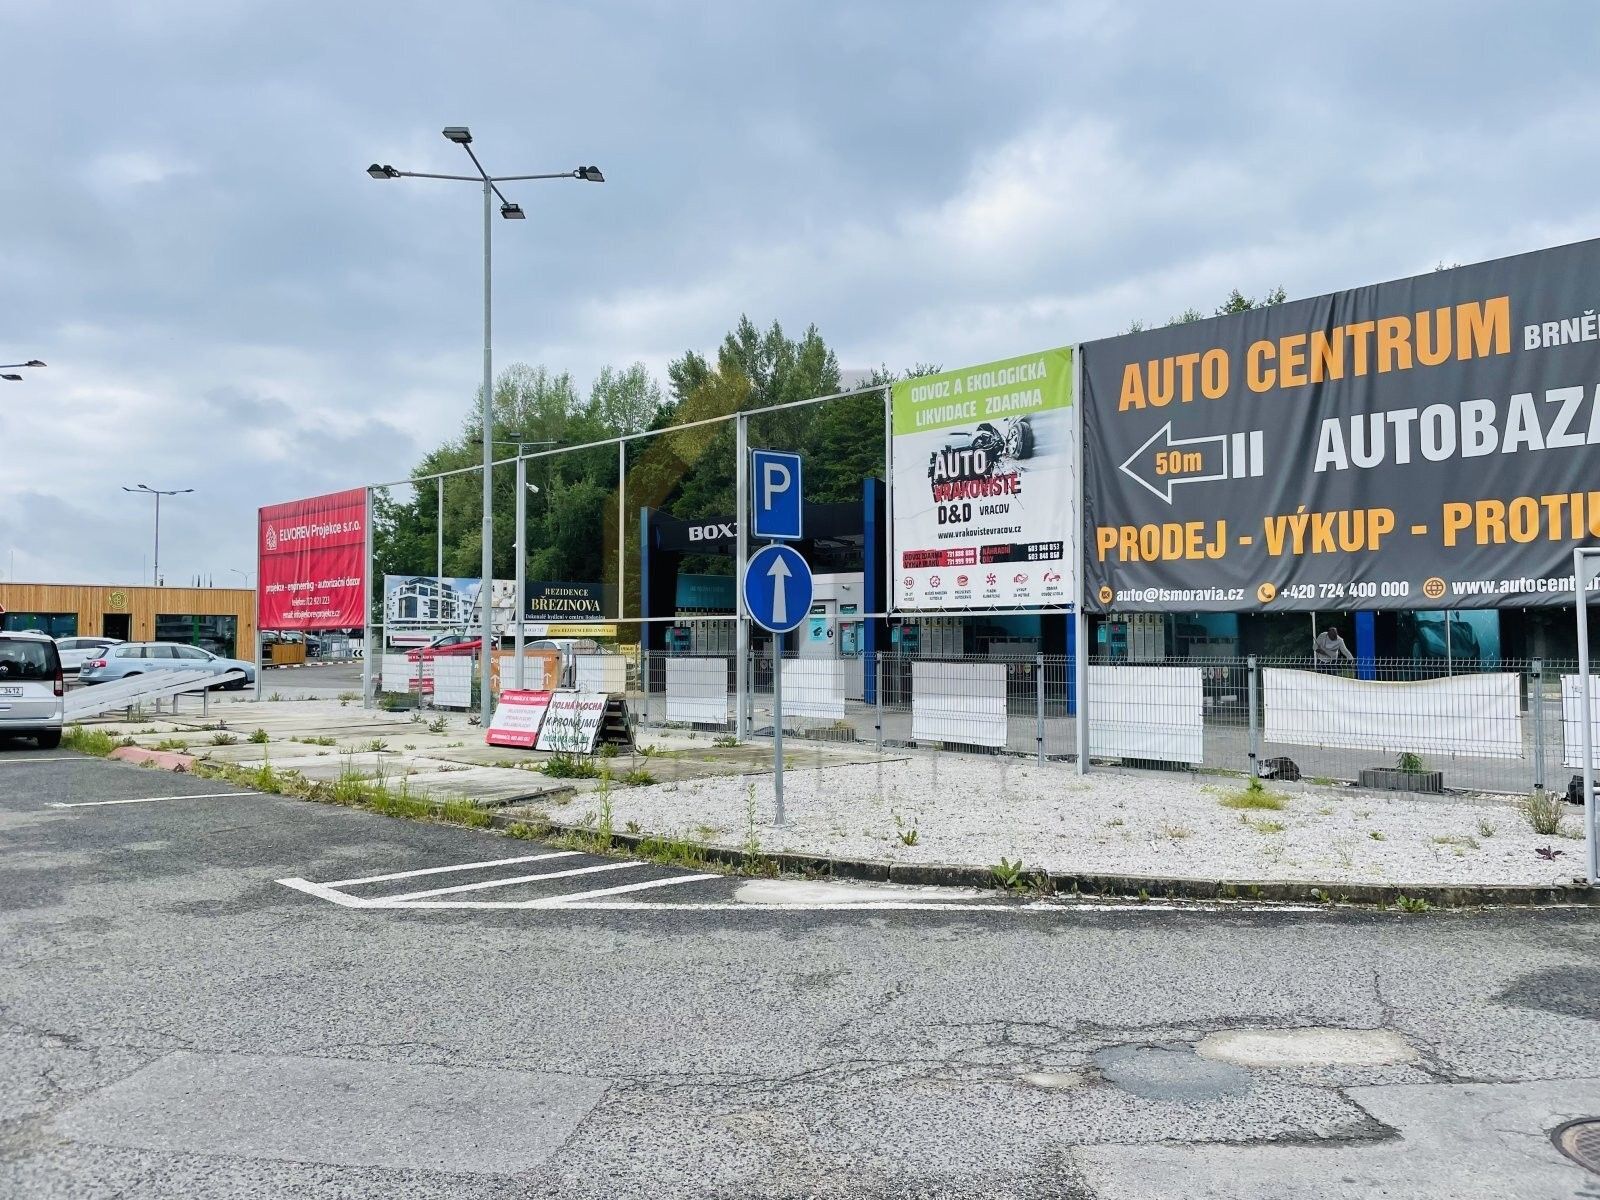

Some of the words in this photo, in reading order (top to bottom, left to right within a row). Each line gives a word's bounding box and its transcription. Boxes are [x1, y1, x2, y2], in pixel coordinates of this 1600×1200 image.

[1524, 309, 1600, 351] BRNĚ
[1118, 348, 1229, 412] AUTO
[1247, 295, 1512, 393] CENTRUM
[911, 381, 950, 403] ODVOZ
[954, 378, 962, 395] A
[967, 360, 1047, 392] EKOLOGICKÁ
[916, 400, 977, 426] LIKVIDACE
[985, 388, 1042, 414] ZDARMA
[934, 449, 986, 479] AUTO
[1156, 450, 1202, 475] 50m
[763, 462, 791, 511] P
[938, 503, 972, 524] D&D
[979, 503, 1009, 516] VRACOV
[280, 525, 310, 541] ELVOREV
[311, 522, 341, 539] Projekce
[343, 520, 361, 533] s.r.o.
[938, 526, 1021, 539] www.vrakovistevracov.cz
[1097, 520, 1226, 563] PRODEJ
[1264, 505, 1395, 557] VÝKUP
[531, 596, 600, 612] BŘEZINOVA
[545, 588, 589, 596] REZIDENCE
[1116, 587, 1244, 602] auto@tsmoravia.cz
[1280, 584, 1316, 599] +420
[1318, 583, 1345, 598] 724
[1349, 582, 1378, 598] 400
[1380, 581, 1410, 598] 000
